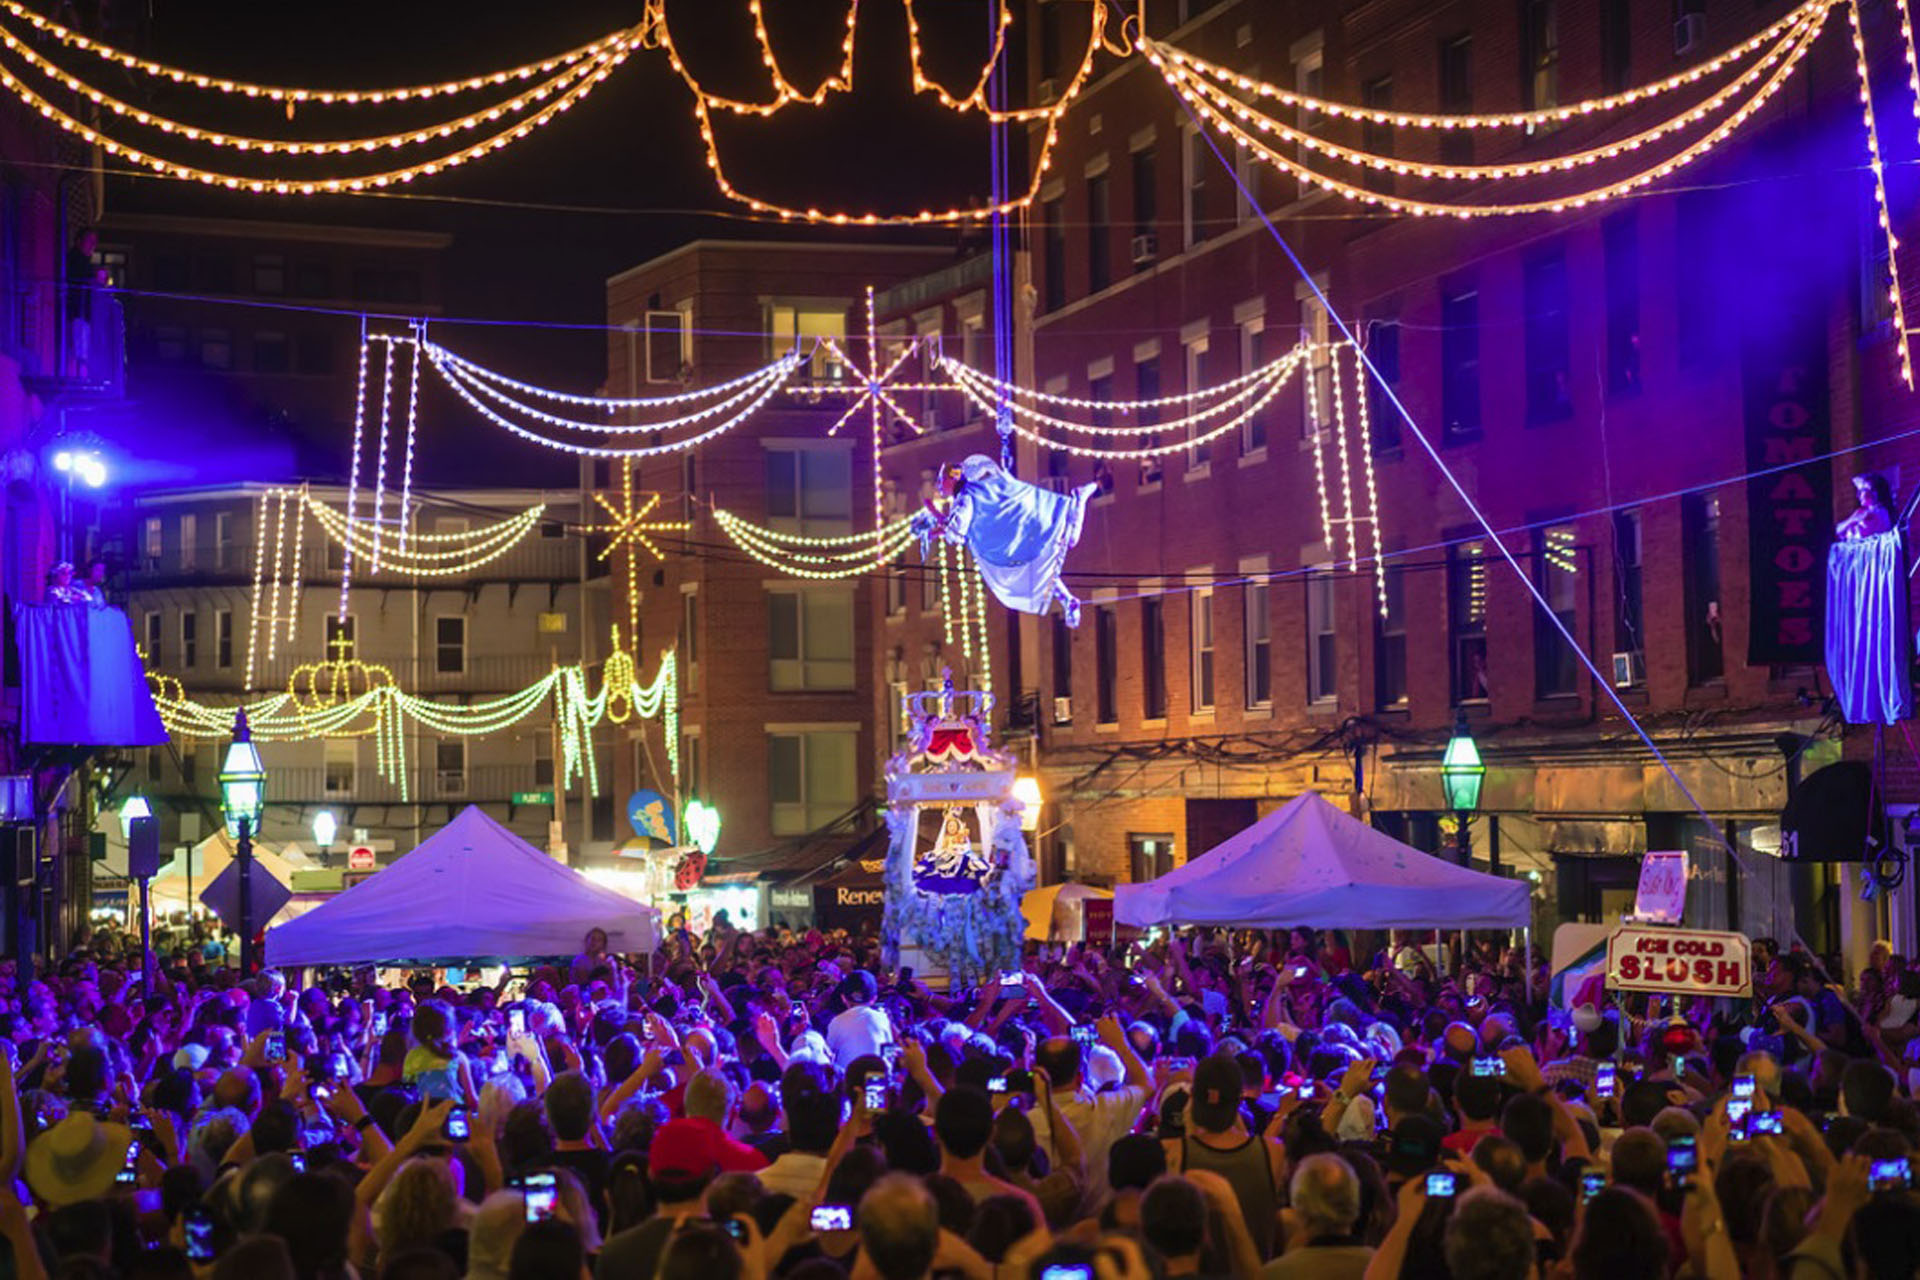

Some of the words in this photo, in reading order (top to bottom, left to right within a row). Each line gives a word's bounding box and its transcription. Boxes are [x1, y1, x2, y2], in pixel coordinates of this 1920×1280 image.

[1636, 938, 1669, 954] ICE
[1673, 940, 1725, 957] COLD
[1619, 955, 1740, 986] SLUSH
